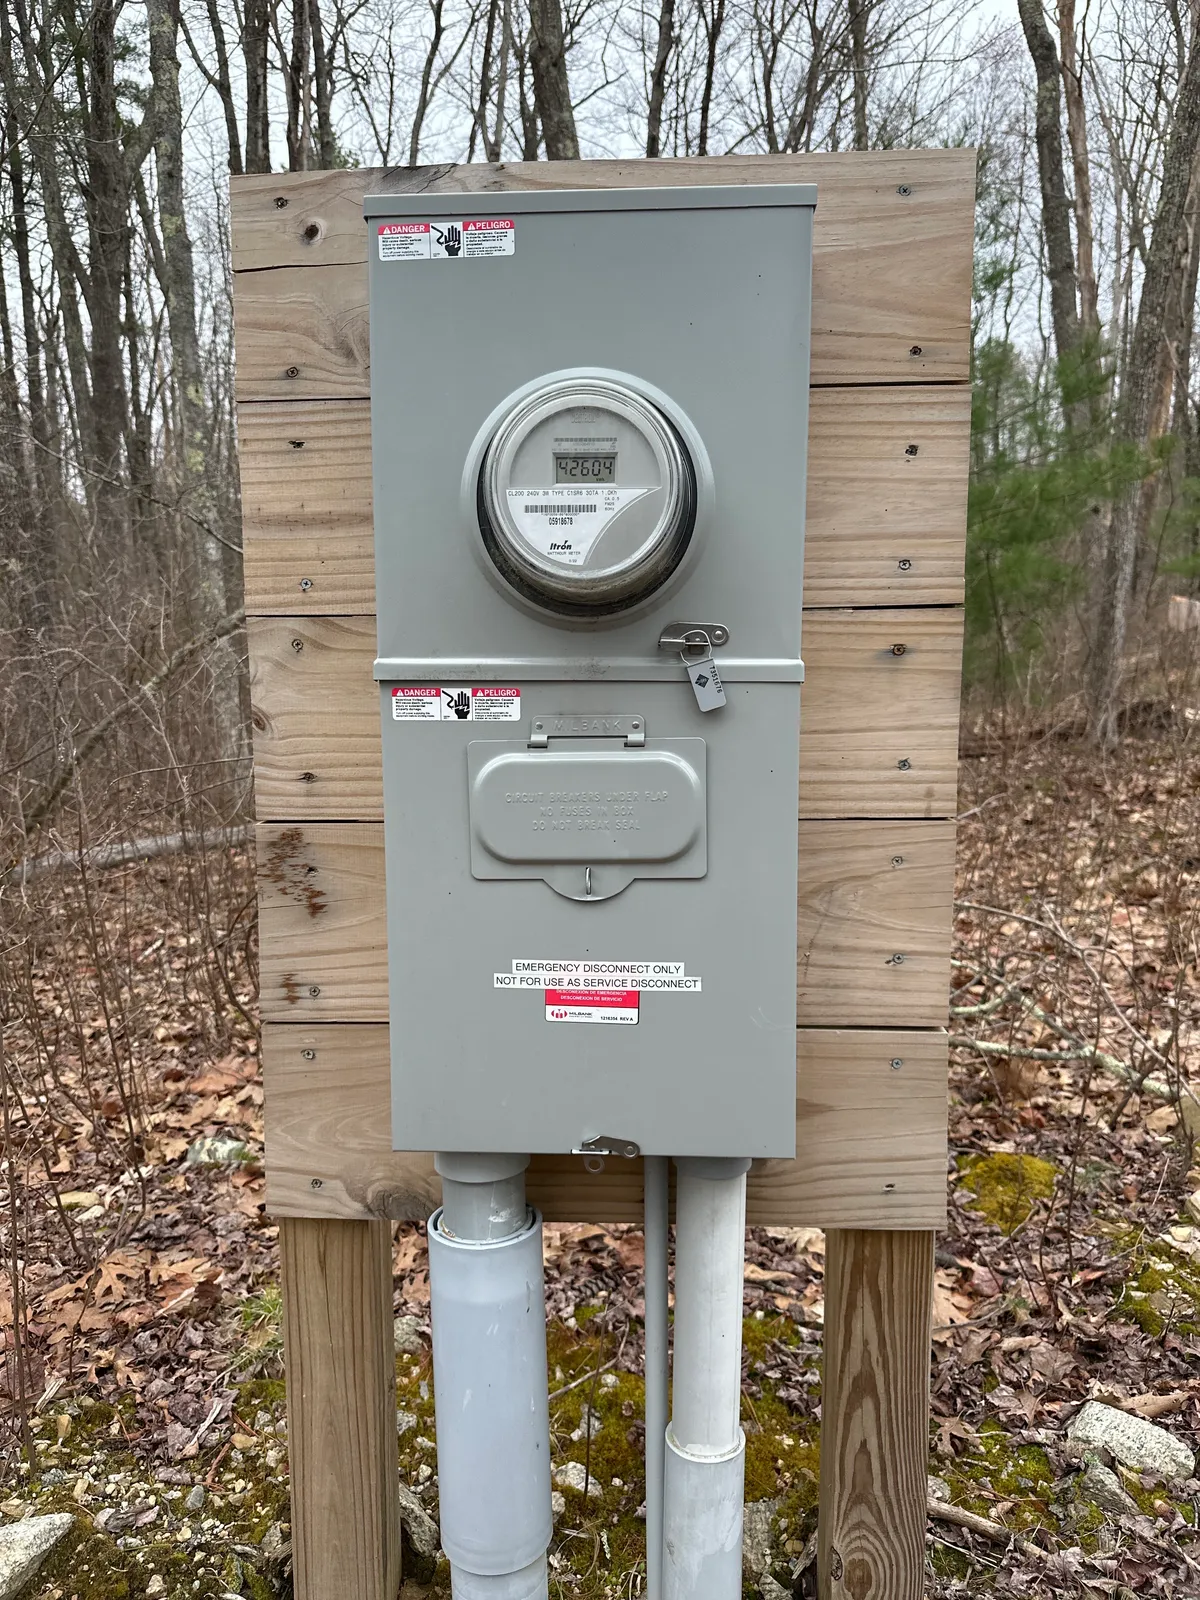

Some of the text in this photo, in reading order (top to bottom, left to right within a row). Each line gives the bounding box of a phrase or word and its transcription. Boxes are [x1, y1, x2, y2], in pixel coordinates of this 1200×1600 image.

[391, 225, 425, 233] DANGER
[476, 221, 510, 229] PELIGRO
[559, 460, 612, 476] 42604
[549, 517, 573, 525] 05918678
[554, 720, 621, 731] MILBANK
[505, 791, 668, 803] CIRCUIT BREAKERS UNDER FLAP
[540, 806, 634, 817] NO FUSES IN BOX
[532, 820, 641, 831] DO NOT BREAK SEAL
[515, 963, 681, 974] EMERGENCY DISCONNECT ONLY
[496, 976, 699, 988] NOT FOR USE AS SERVICE DISCONNECT
